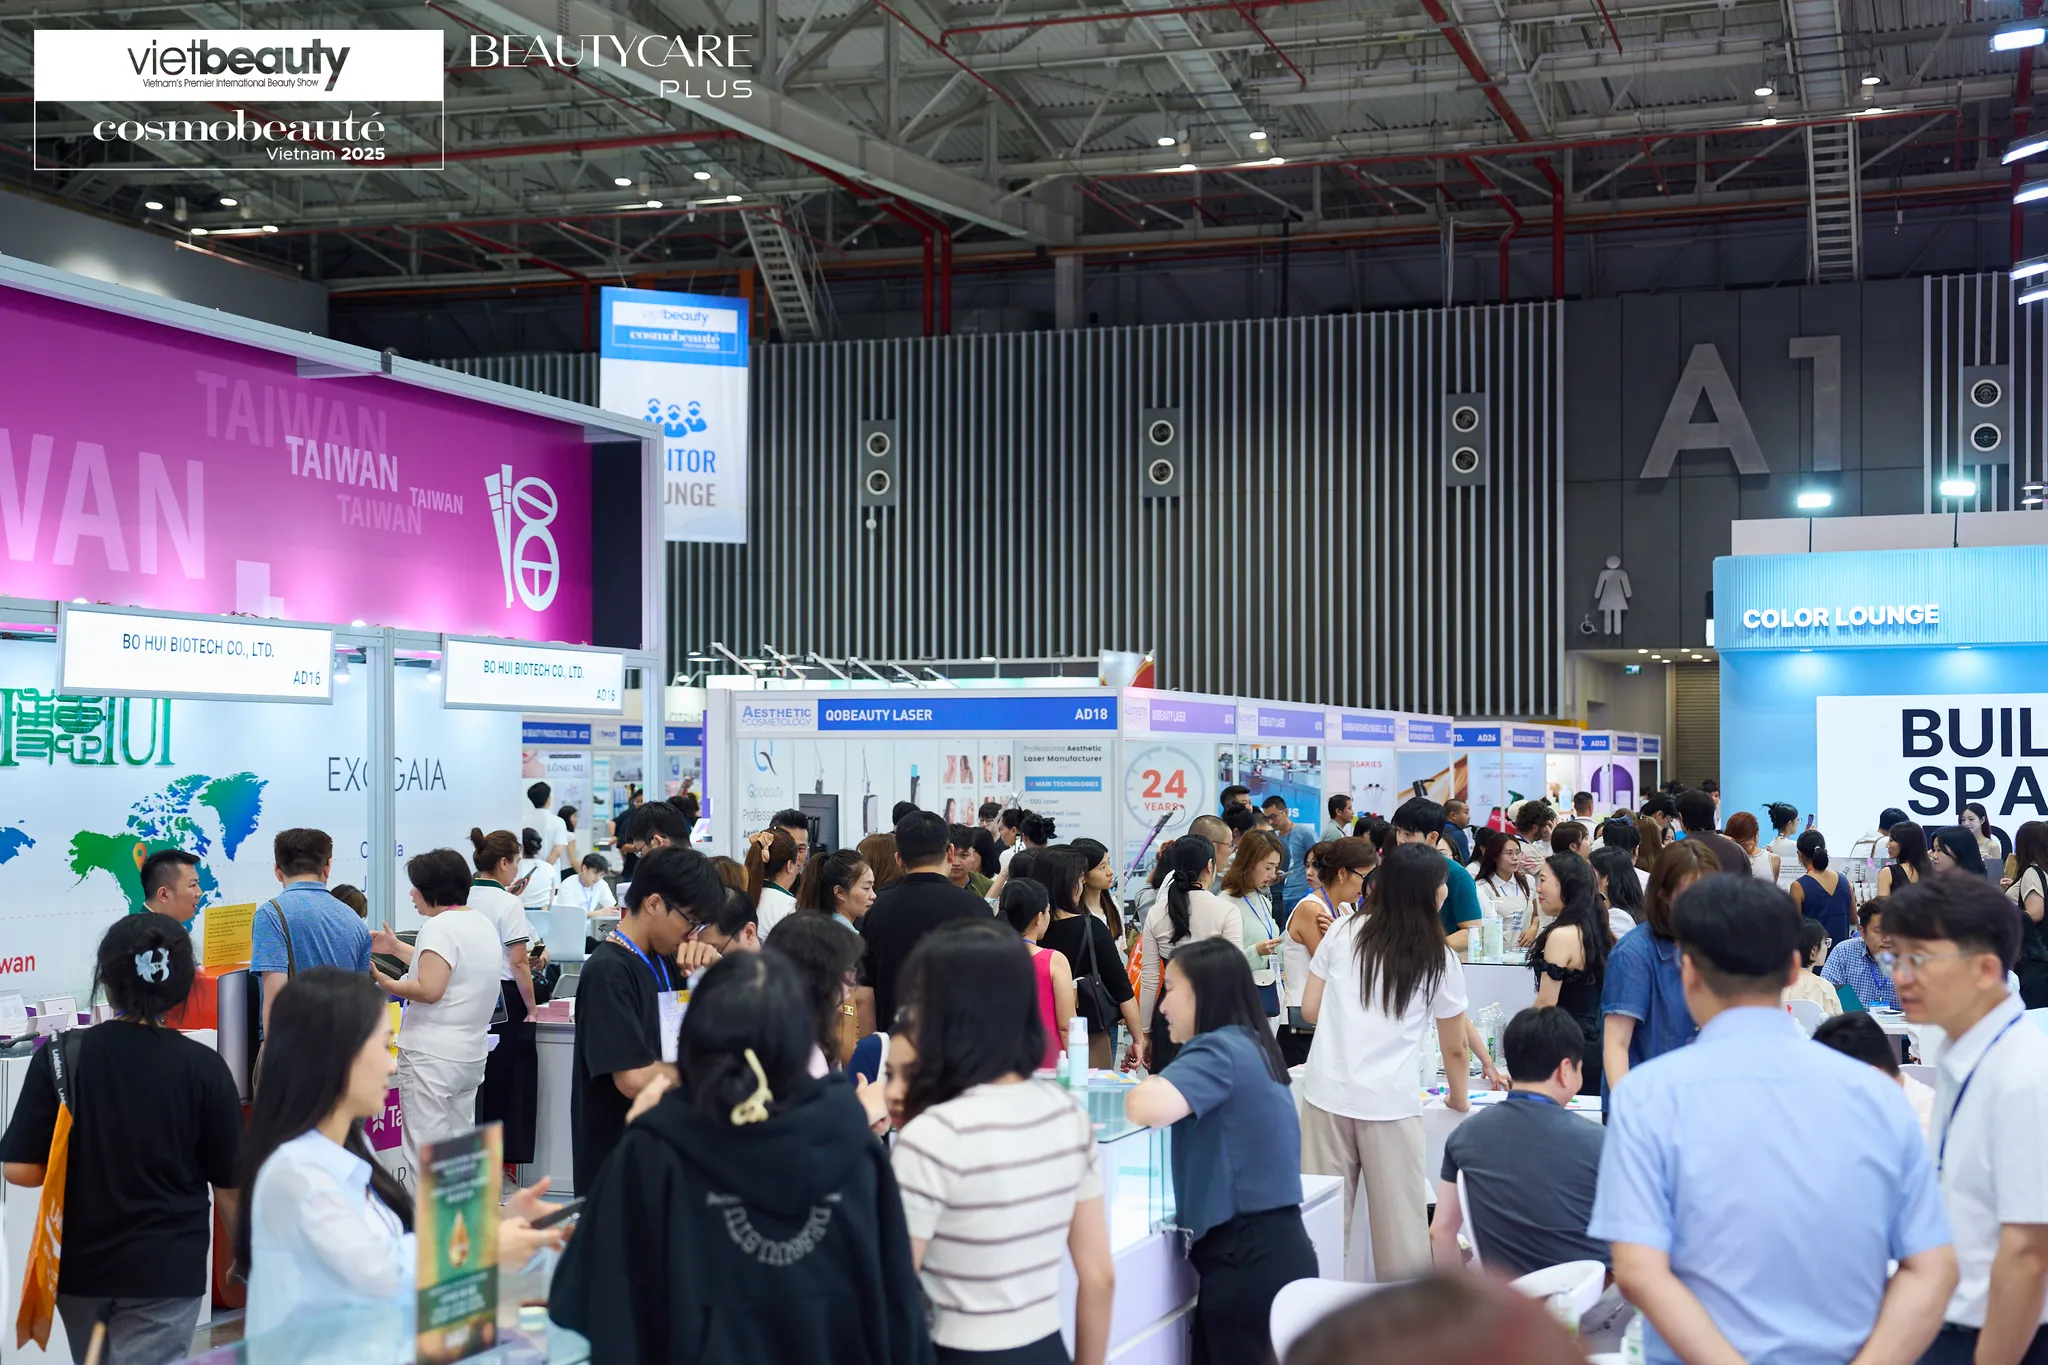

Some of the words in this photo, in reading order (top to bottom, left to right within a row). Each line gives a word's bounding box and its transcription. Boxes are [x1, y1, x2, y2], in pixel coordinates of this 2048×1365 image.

[195, 369, 388, 462] TAIWAN
[285, 434, 398, 493] TAIWAN
[667, 448, 716, 473] ITOR
[409, 486, 463, 515] TAIWAN
[664, 482, 716, 507] UNGE
[337, 493, 422, 535] TAIWAN
[1743, 607, 1830, 629] COLOR
[1835, 604, 1940, 626] LOUNGE
[122, 633, 141, 650] BO
[145, 634, 167, 652] HUI
[170, 636, 224, 655] BIOTECH
[227, 640, 249, 659] CO.,
[252, 642, 275, 658] LTD.
[293, 670, 321, 686] AD16
[484, 660, 496, 674] BO
[498, 661, 513, 675] HUI
[515, 662, 550, 677] BIOTECH
[569, 666, 585, 679] LTD.
[596, 689, 616, 702] AD16
[742, 705, 812, 718] AESTHETIC
[825, 708, 889, 722] QOBEAUTY
[892, 708, 933, 721] LASER
[1075, 707, 1108, 720] AD18
[1477, 734, 1497, 742] AD26
[1902, 707, 2048, 758] BUIL
[1142, 769, 1188, 799] 24
[1907, 765, 2048, 816] SPA
